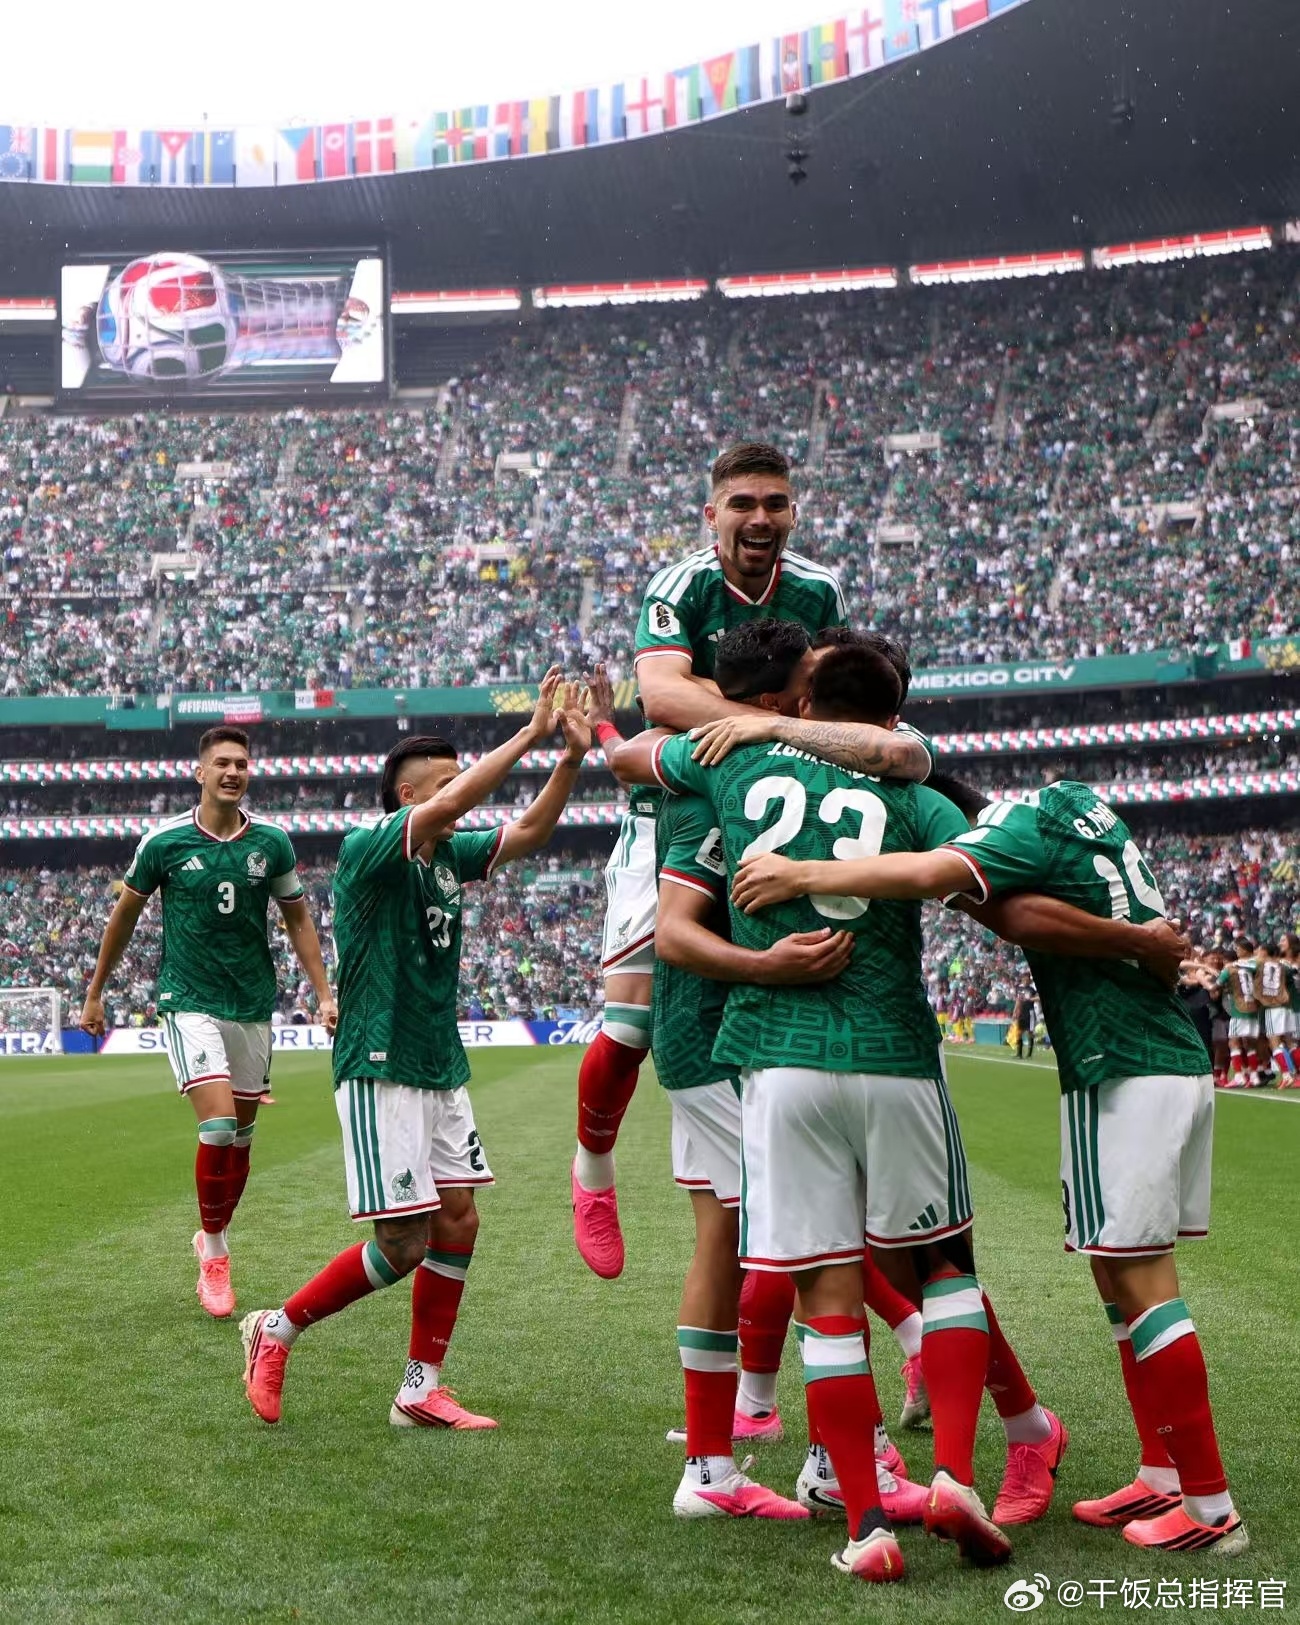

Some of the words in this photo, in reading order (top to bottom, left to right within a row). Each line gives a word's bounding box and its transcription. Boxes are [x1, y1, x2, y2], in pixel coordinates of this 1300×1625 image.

[909, 669, 1009, 690] MEXICO
[1013, 664, 1076, 684] CITY
[217, 881, 235, 915] 3
